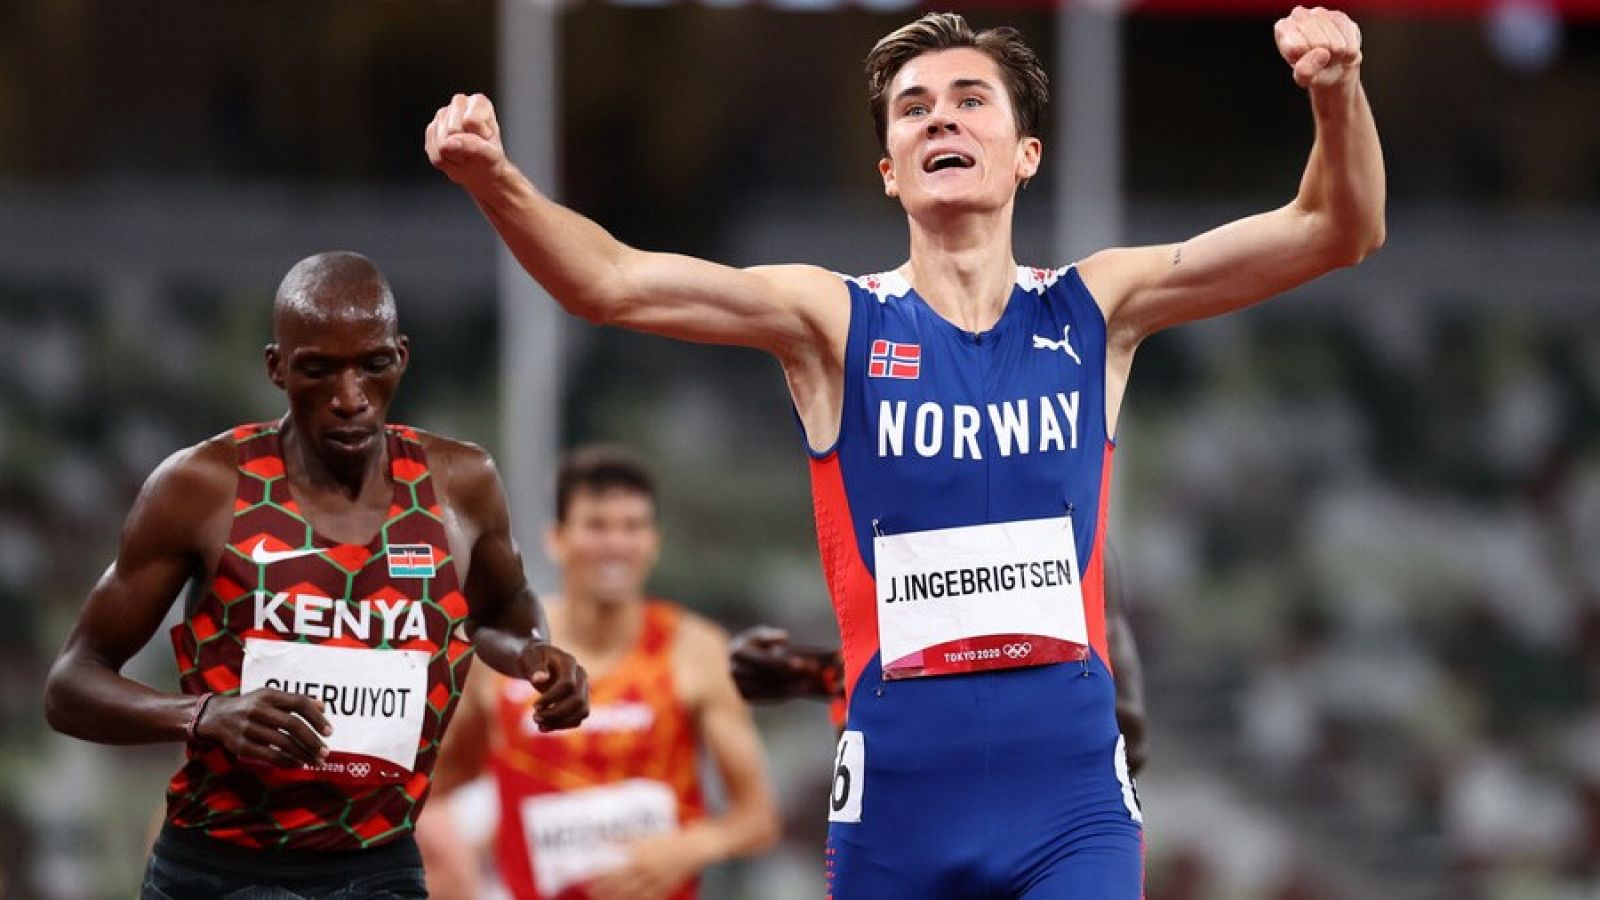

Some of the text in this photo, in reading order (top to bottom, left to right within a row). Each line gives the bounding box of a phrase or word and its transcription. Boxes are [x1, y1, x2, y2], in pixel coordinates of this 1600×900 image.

[877, 391, 1080, 460] NORWAY
[885, 559, 1073, 604] J.INGEBRIGTSEN
[252, 590, 428, 641] KENYA
[944, 648, 1000, 663] TOKYO 2020
[832, 740, 851, 812] 6
